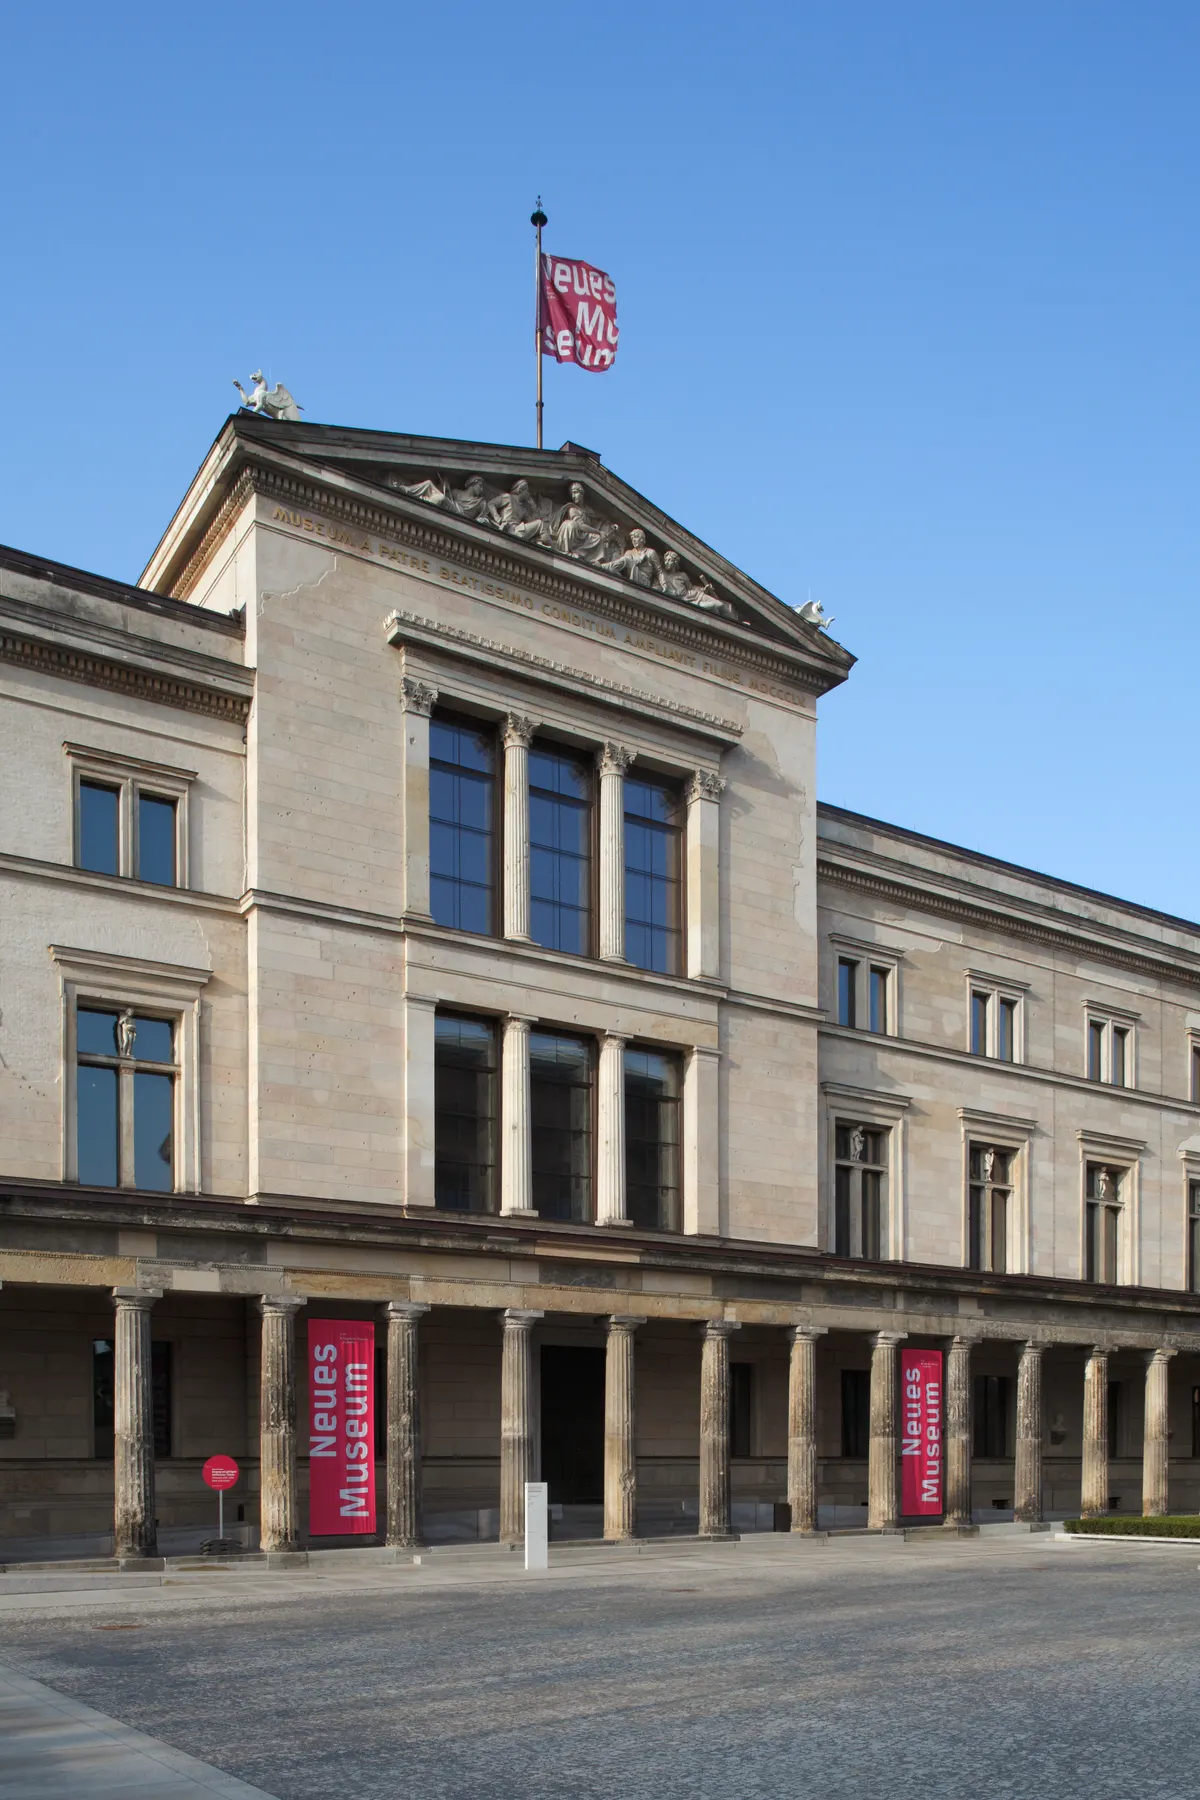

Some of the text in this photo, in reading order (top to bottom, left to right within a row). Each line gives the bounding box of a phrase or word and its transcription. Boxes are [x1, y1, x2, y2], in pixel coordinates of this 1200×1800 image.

[272, 506, 354, 547] MUSEUM
[360, 538, 373, 554] A
[379, 543, 430, 574] PATRE
[439, 566, 534, 610] BEATISSIMO
[541, 603, 617, 641] CONDITUM
[309, 1343, 338, 1457] Neues
[339, 1362, 370, 1517] Museum
[901, 1367, 922, 1456] Neues
[921, 1382, 941, 1503] Museum
